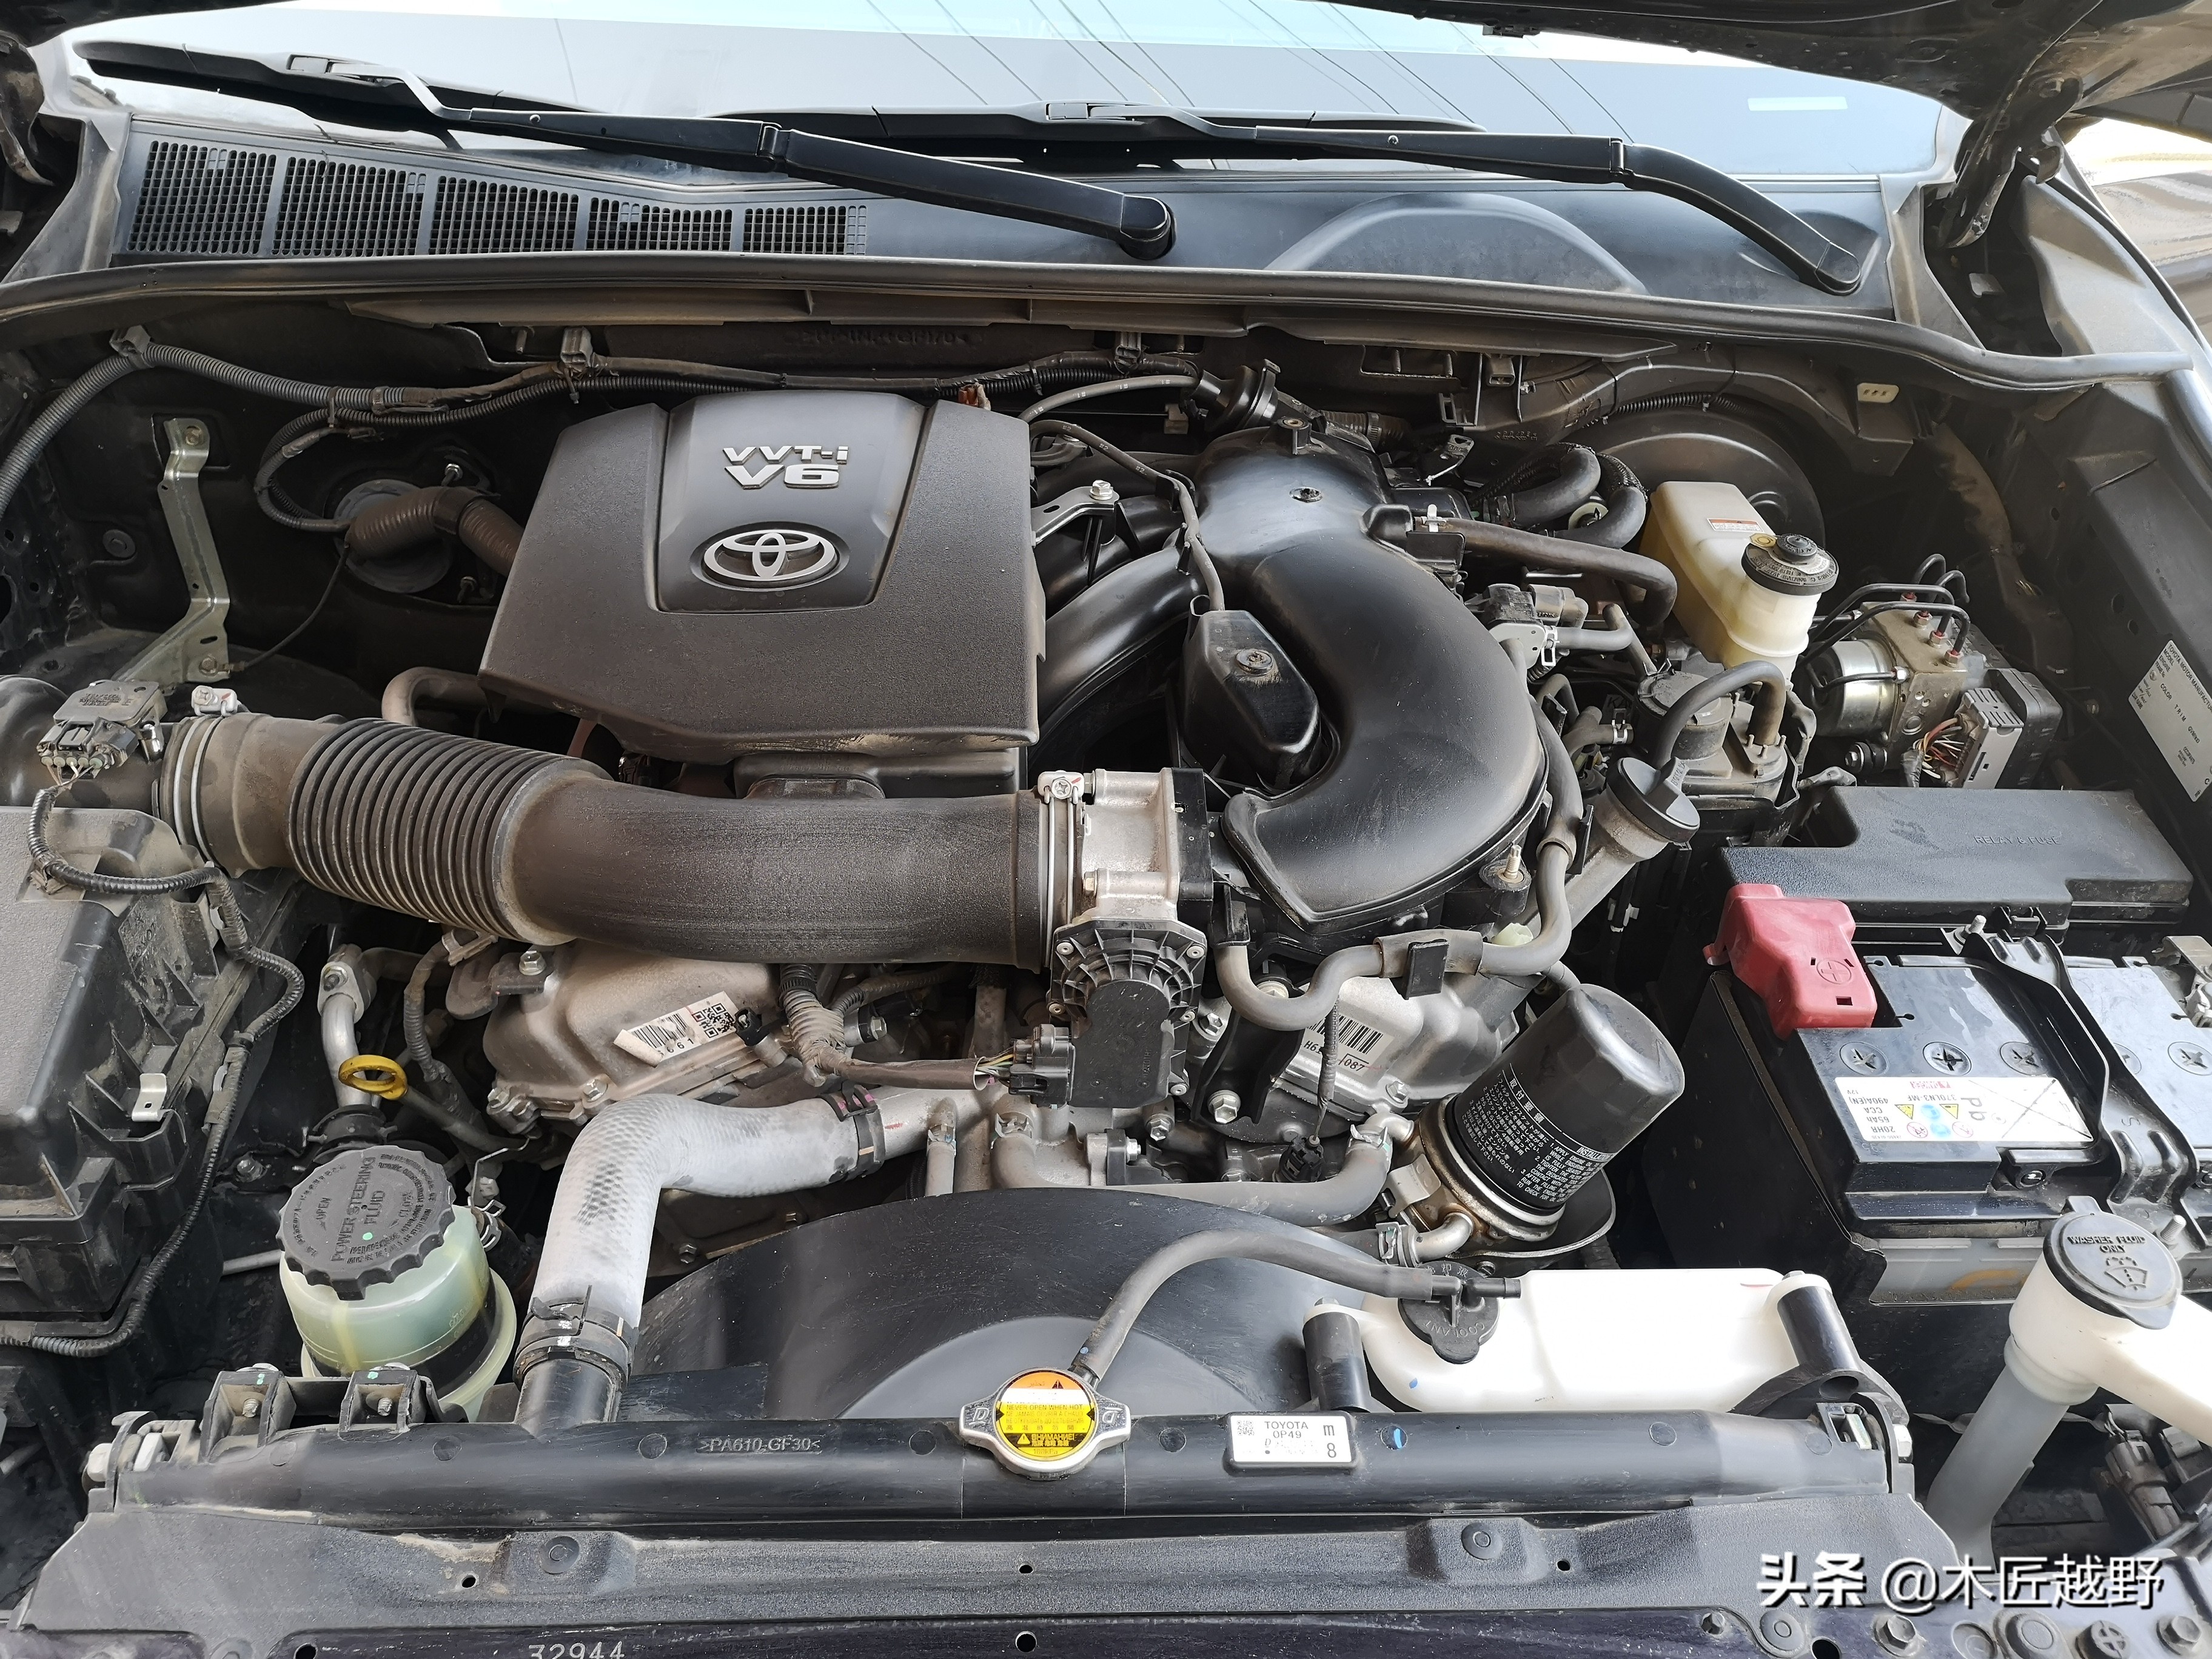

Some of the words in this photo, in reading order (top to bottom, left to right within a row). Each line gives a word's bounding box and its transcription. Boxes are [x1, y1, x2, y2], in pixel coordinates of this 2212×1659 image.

[722, 446, 850, 464] VVT-i
[724, 464, 840, 489] V6
[2162, 648, 2175, 666] MODEL
[2168, 644, 2181, 663] TOYOTA
[2179, 662, 2192, 680] MOTOR
[2160, 683, 2172, 700] COLOR
[2173, 704, 2186, 722] TRIM
[1509, 1078, 1545, 1124] 取付要領
[1549, 1150, 1565, 1161] WHILE
[1564, 1159, 1586, 1171] ENSURING
[1553, 1146, 1569, 1156] APPLY
[1569, 1155, 1586, 1165] ENGINE
[1529, 1168, 1551, 1181] CONTACT
[1539, 1159, 1560, 1172] TIGHTEN
[1551, 1159, 1566, 1169] FULLY
[1566, 1165, 1581, 1176] SEATED
[1524, 1172, 1541, 1183] AFTER
[1540, 1181, 1557, 1191] FILLING
[1545, 1170, 1568, 1184] DEDICATED
[1520, 1176, 1532, 1185] RUN
[1542, 1187, 1558, 1198] ENGINE
[1524, 1186, 1540, 1196] CHECK
[330, 1218, 357, 1261] POWER
[346, 1158, 375, 1215] STEERING
[364, 1191, 385, 1224] FLUID
[2067, 1236, 2114, 1244] WASHER
[2100, 1245, 2125, 1253] ONLY
[1426, 1321, 1485, 1337] COOLANT
[1323, 1425, 1335, 1436] m
[1327, 1443, 1336, 1458] 8
[529, 1641, 625, 1659] 32944
